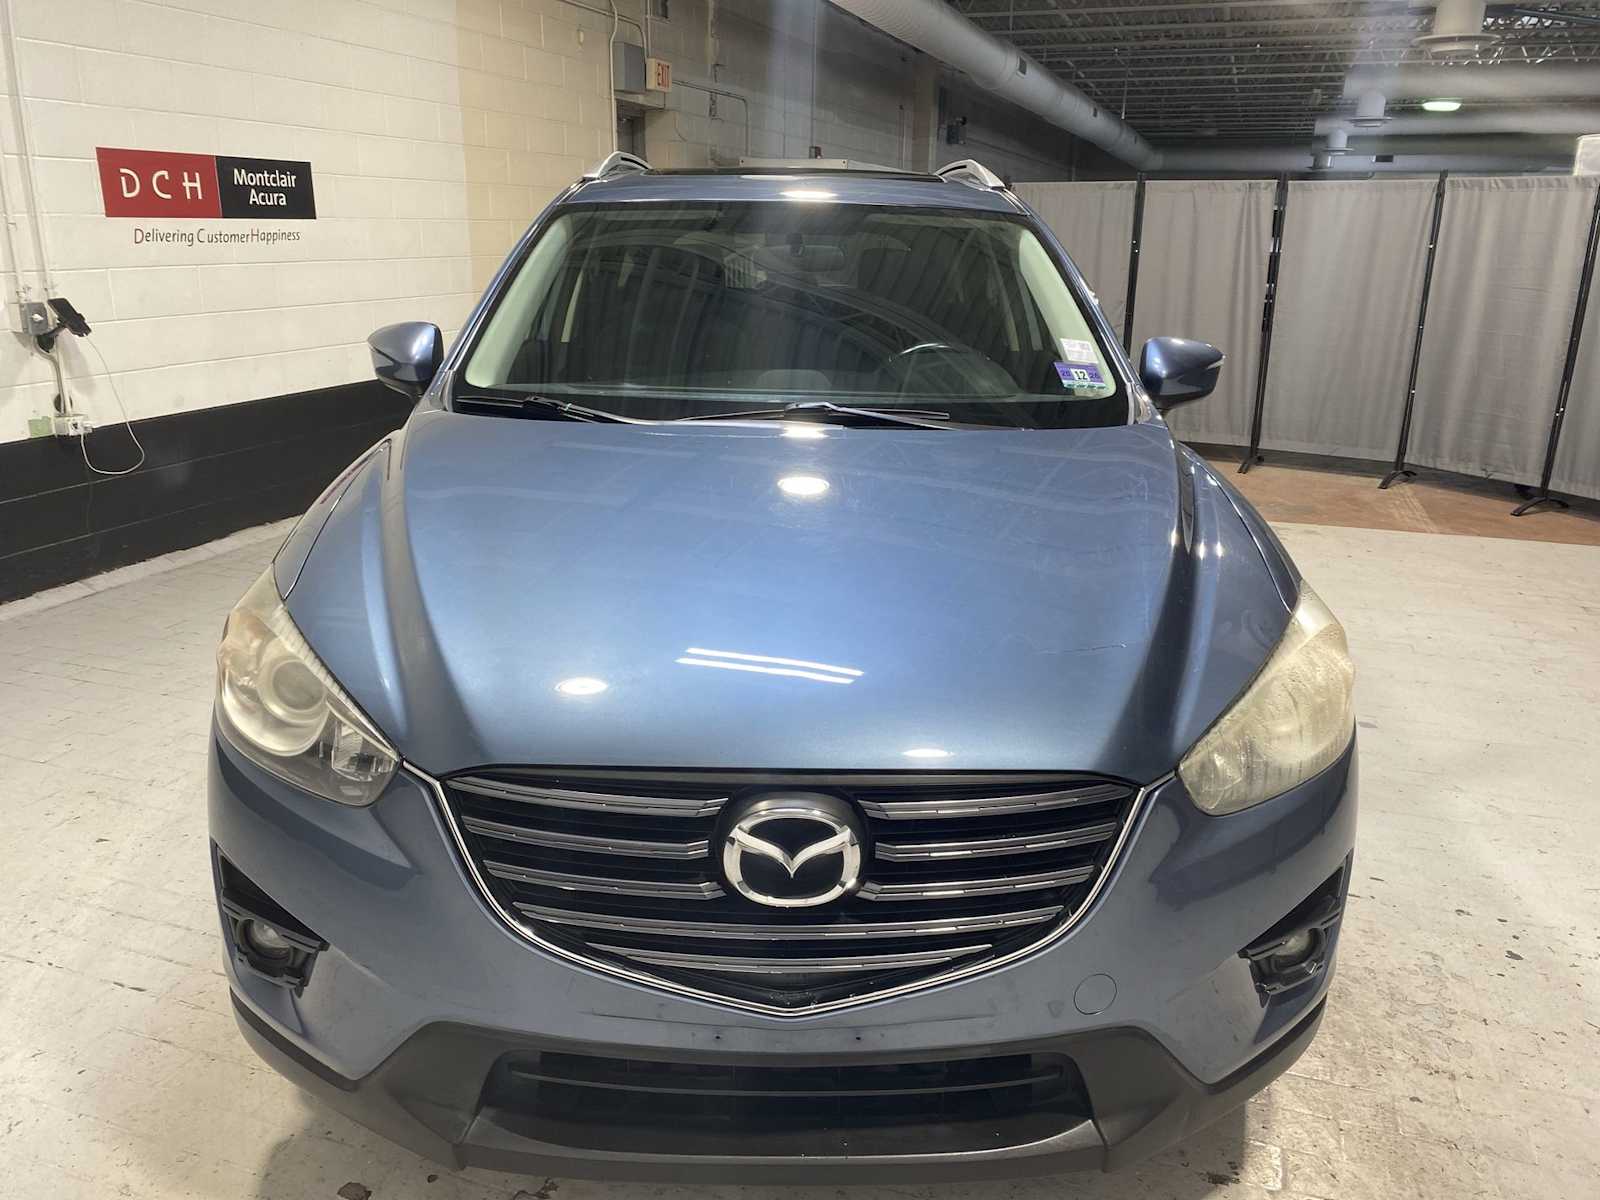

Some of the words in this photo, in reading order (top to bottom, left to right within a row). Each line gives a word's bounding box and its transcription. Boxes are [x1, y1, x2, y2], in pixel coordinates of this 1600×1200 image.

[656, 63, 670, 88] EXIT
[233, 168, 296, 188] Montclair
[249, 189, 287, 206] Acura
[134, 228, 194, 246] Delivering
[1074, 371, 1088, 380] 12
